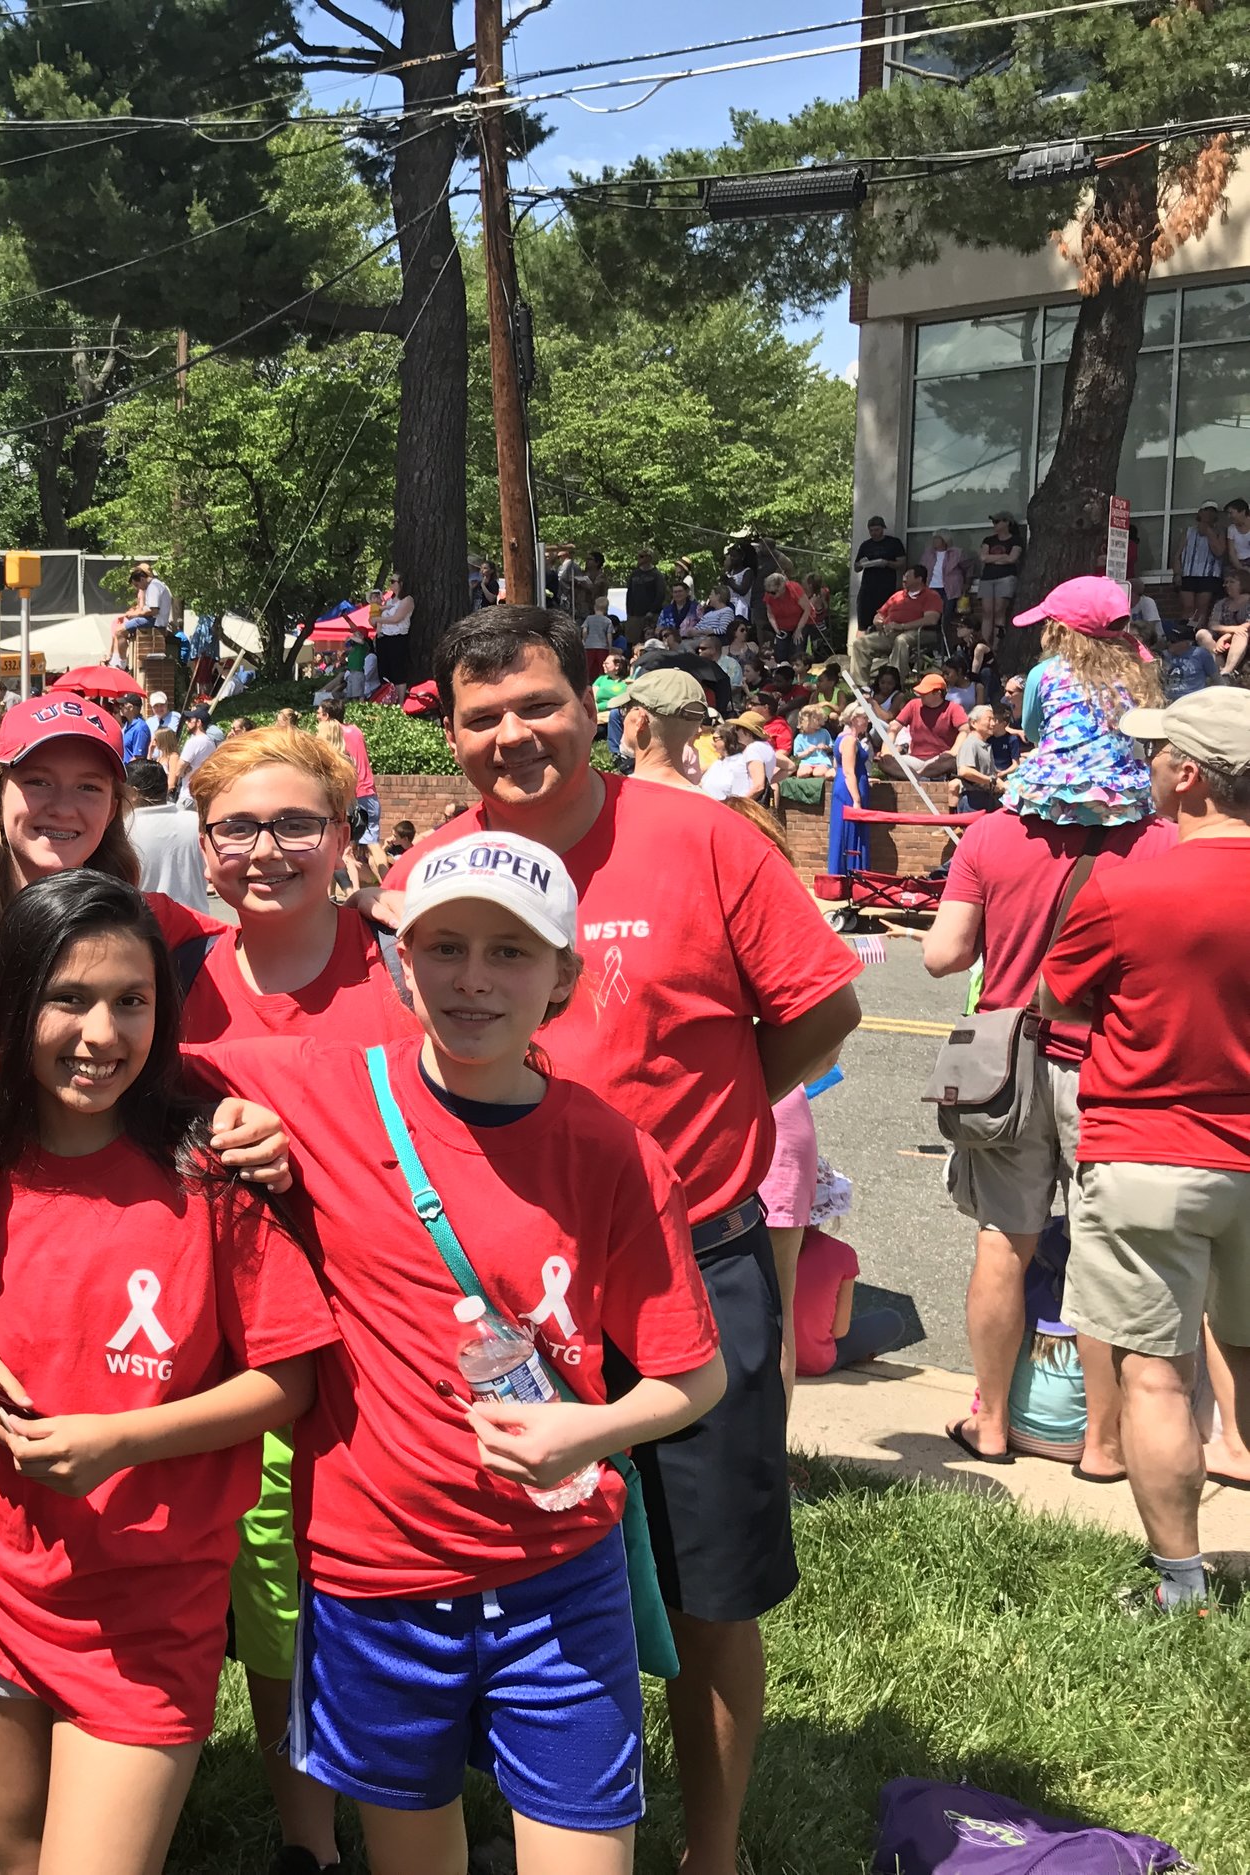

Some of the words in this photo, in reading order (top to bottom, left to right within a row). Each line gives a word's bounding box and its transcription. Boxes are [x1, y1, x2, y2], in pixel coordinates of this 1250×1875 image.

[31, 701, 108, 736] USA
[424, 855, 460, 883] US
[470, 847, 552, 894] OPEN
[584, 920, 650, 941] WSTG
[105, 1353, 174, 1381] WSTG
